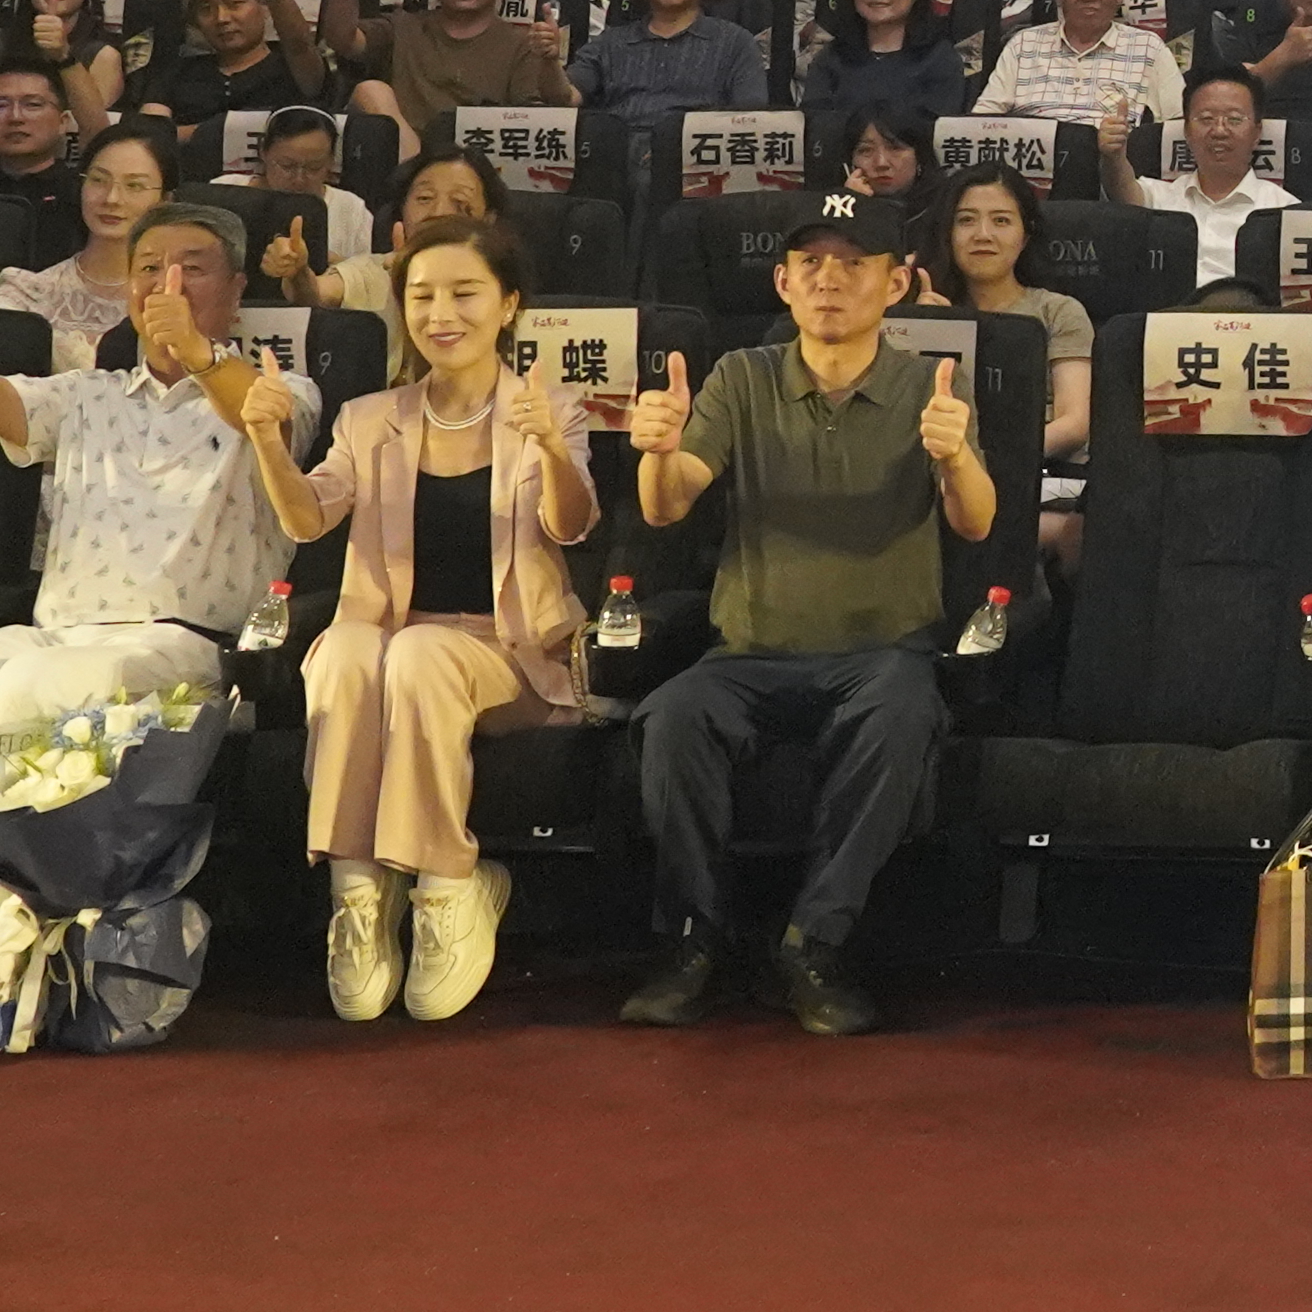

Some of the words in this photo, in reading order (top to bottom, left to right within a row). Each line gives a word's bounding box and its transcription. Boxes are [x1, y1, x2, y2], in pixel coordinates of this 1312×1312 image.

[1044, 0, 1052, 14] 7
[1246, 8, 1256, 22] 8
[463, 126, 570, 163] 李军练
[580, 141, 591, 159] 5
[690, 131, 796, 167] 石香莉
[940, 136, 1046, 172] 黄献松
[1290, 147, 1302, 165] 8
[822, 193, 857, 219] NY
[568, 234, 583, 256] 9
[1148, 249, 1165, 271] 11
[318, 351, 333, 375] 9
[1174, 342, 1291, 391] 史佳
[985, 366, 1003, 392] 11
